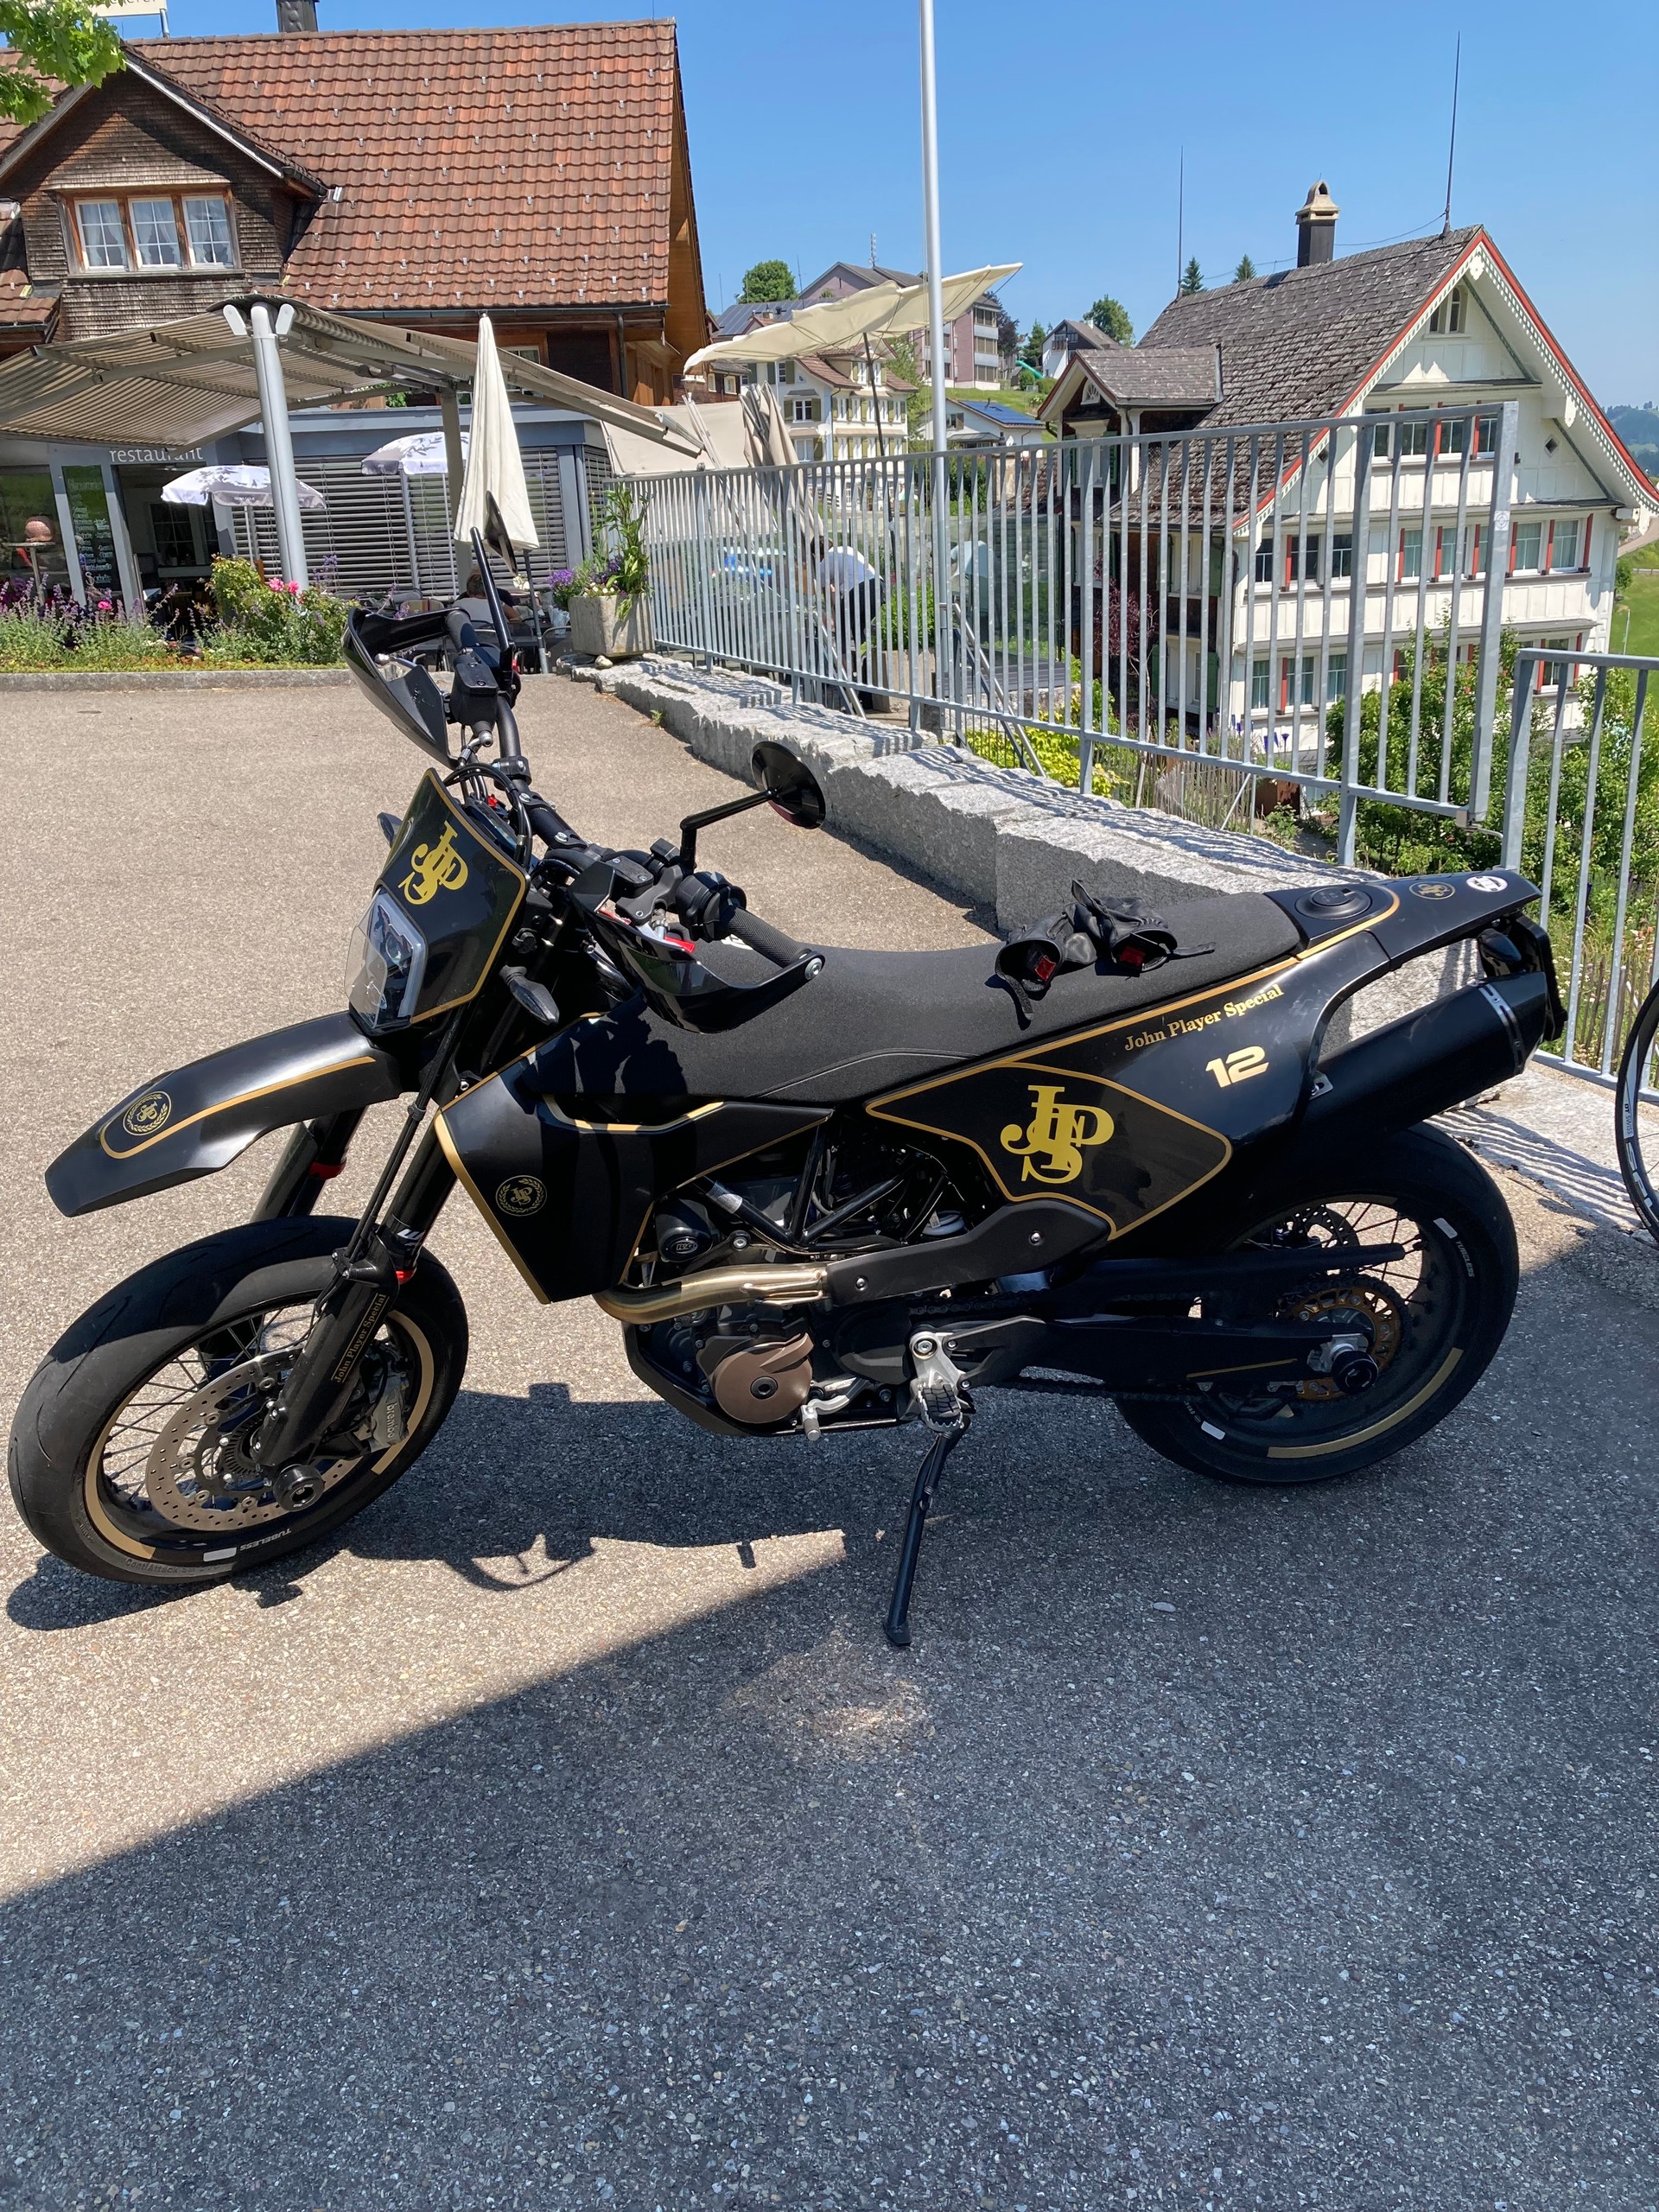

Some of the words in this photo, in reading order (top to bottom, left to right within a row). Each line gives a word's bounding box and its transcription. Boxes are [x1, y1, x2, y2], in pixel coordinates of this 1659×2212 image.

[1124, 1031, 1167, 1052] John
[1166, 1010, 1222, 1038] Player
[1223, 983, 1285, 1018] Special
[1205, 1045, 1270, 1089] 12
[1455, 1240, 1476, 1278] TUBELESS
[334, 1359, 352, 1383] John
[346, 1328, 369, 1359] Player
[363, 1294, 387, 1329] Special
[386, 1402, 398, 1439] brembo
[239, 1527, 292, 1552] TUBELESS
